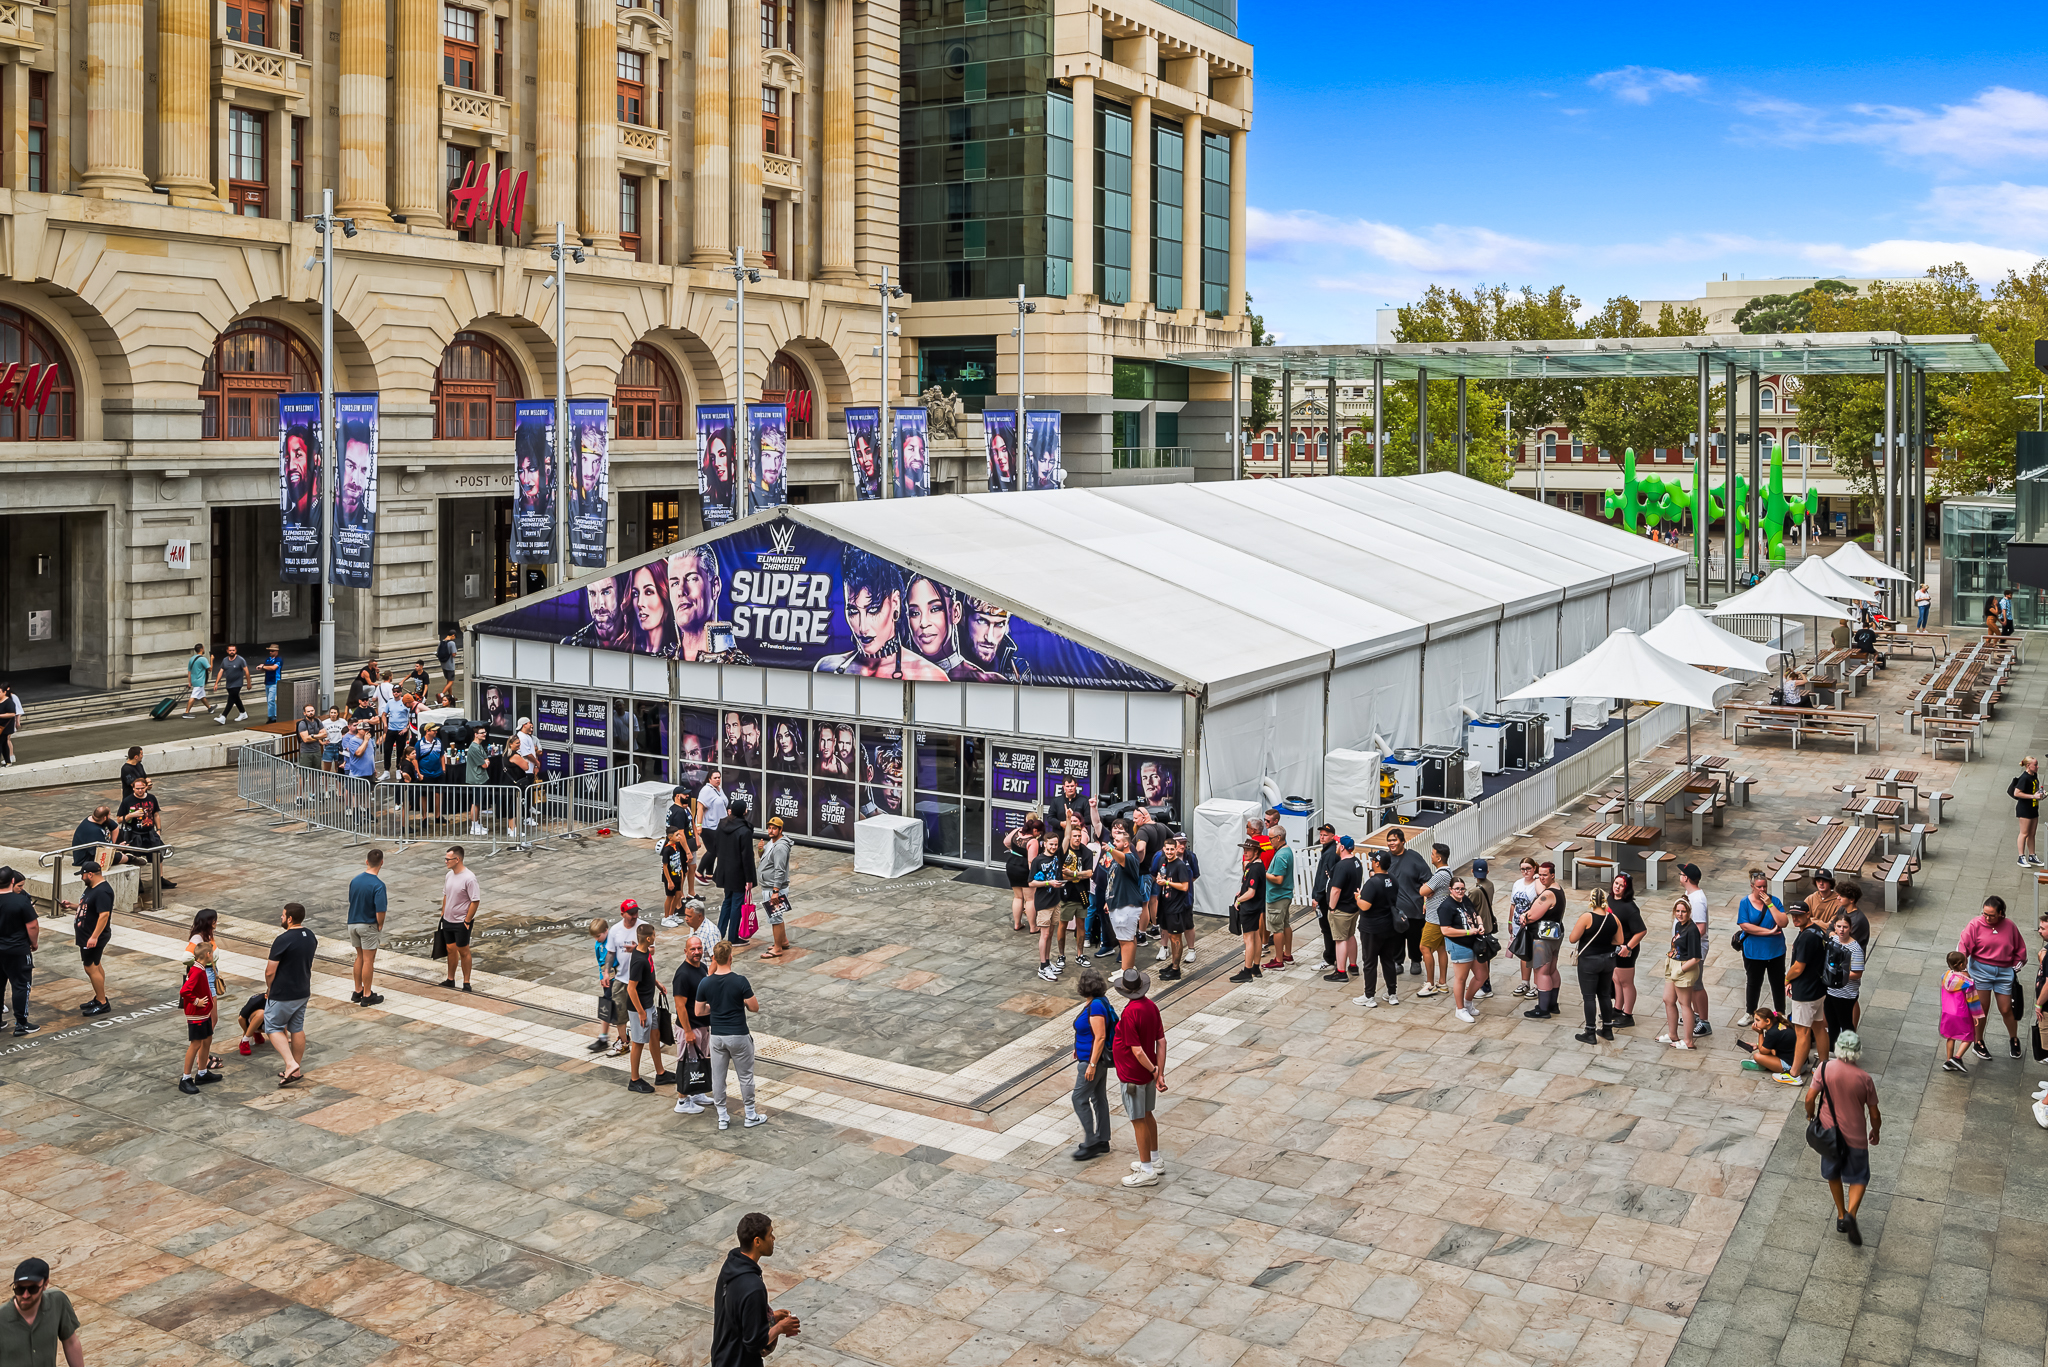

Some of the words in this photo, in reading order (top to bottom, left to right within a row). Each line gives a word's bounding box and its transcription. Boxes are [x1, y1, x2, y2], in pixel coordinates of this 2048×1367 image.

[449, 160, 529, 235] H&M
[460, 475, 491, 487] POST
[757, 555, 807, 565] ELIMINATION
[762, 562, 801, 571] CHAMBER
[730, 570, 831, 608] SUPER
[731, 605, 832, 644] STORE
[551, 700, 568, 709] SUPER
[588, 704, 606, 713] SUPER
[551, 707, 568, 716] STORE
[588, 711, 606, 720] STORE
[539, 722, 568, 734] ENTRANCE
[575, 727, 606, 738] ENTRANCE
[1011, 753, 1036, 763] SUPER
[1063, 758, 1089, 769] SUPER
[1011, 761, 1036, 771] STORE
[1063, 766, 1089, 777] STORE
[1002, 777, 1030, 794] EXIT
[730, 791, 753, 803] SUPER
[775, 797, 799, 809] SUPER
[775, 806, 799, 818] STORE
[821, 804, 846, 815] SUPER
[821, 812, 846, 824] STORE
